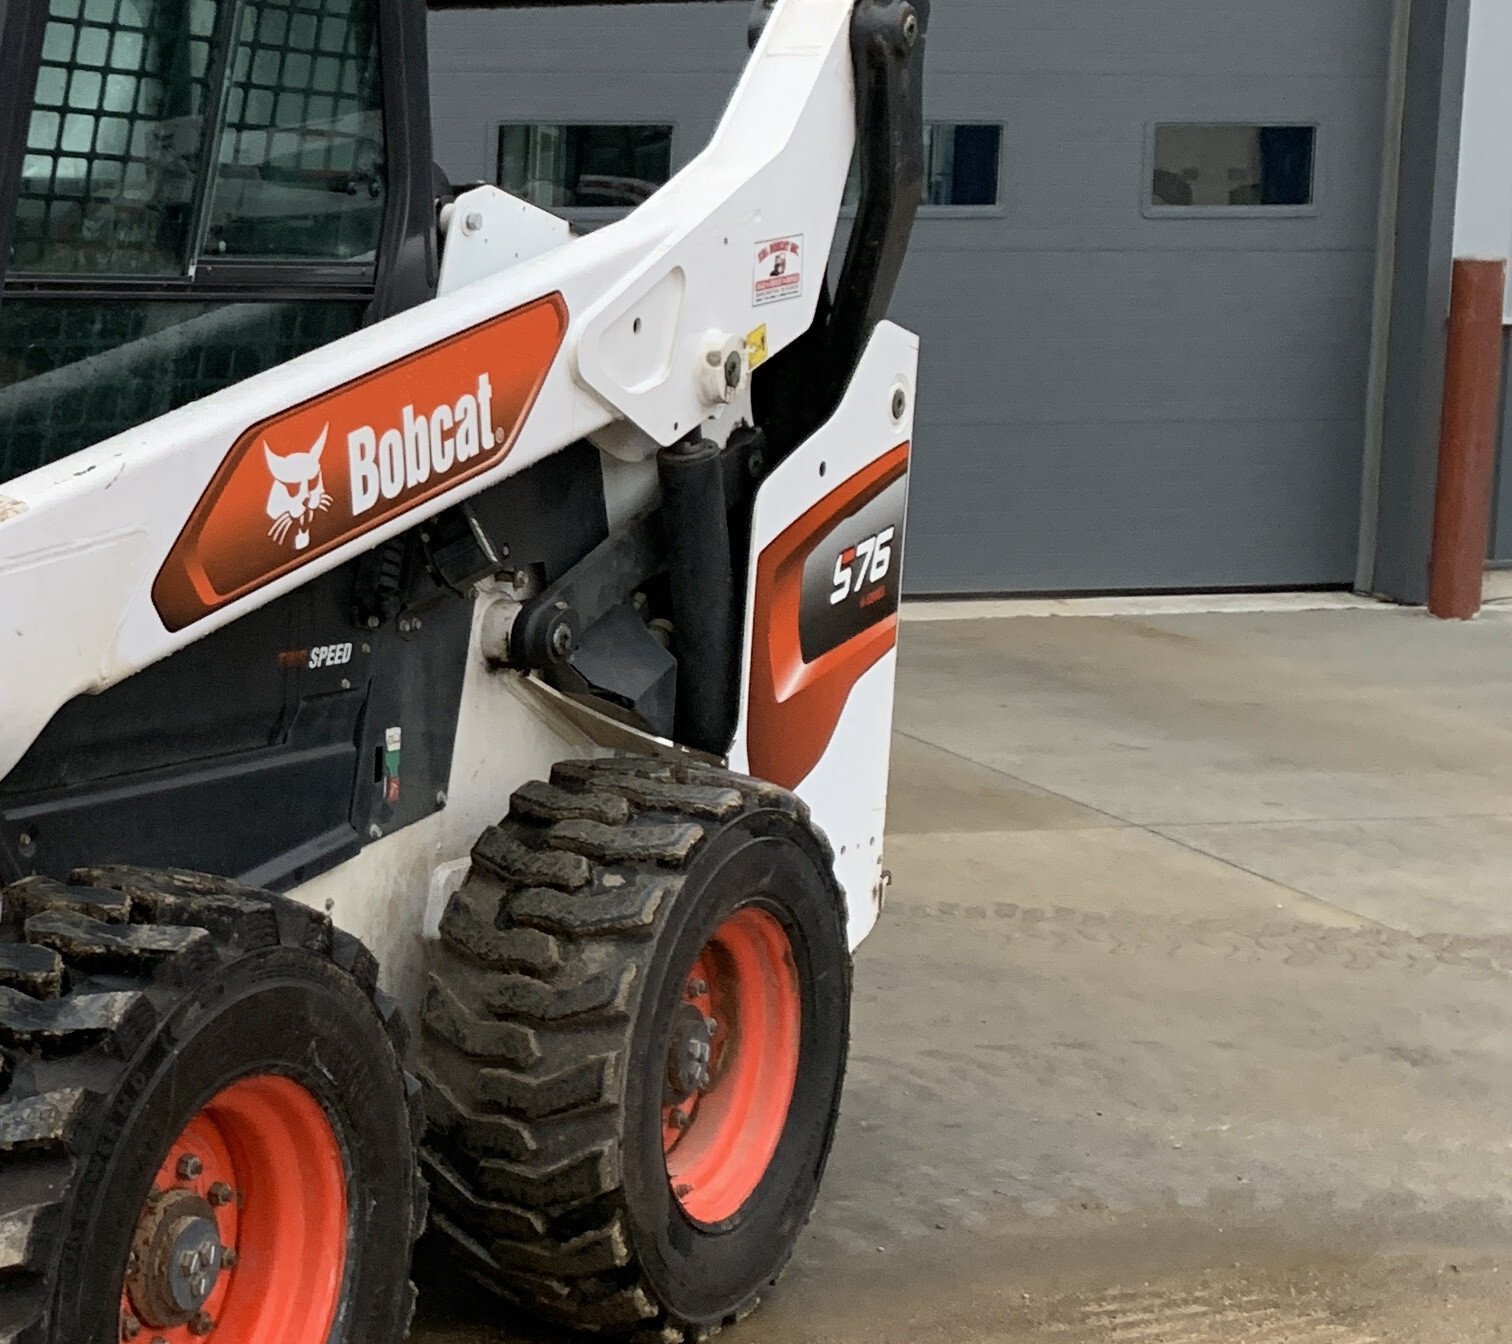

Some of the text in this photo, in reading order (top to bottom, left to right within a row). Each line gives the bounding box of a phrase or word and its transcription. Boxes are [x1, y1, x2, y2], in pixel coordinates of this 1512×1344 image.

[347, 372, 495, 517] Bobcat
[829, 525, 895, 605] S76
[308, 642, 353, 669] SPEED
